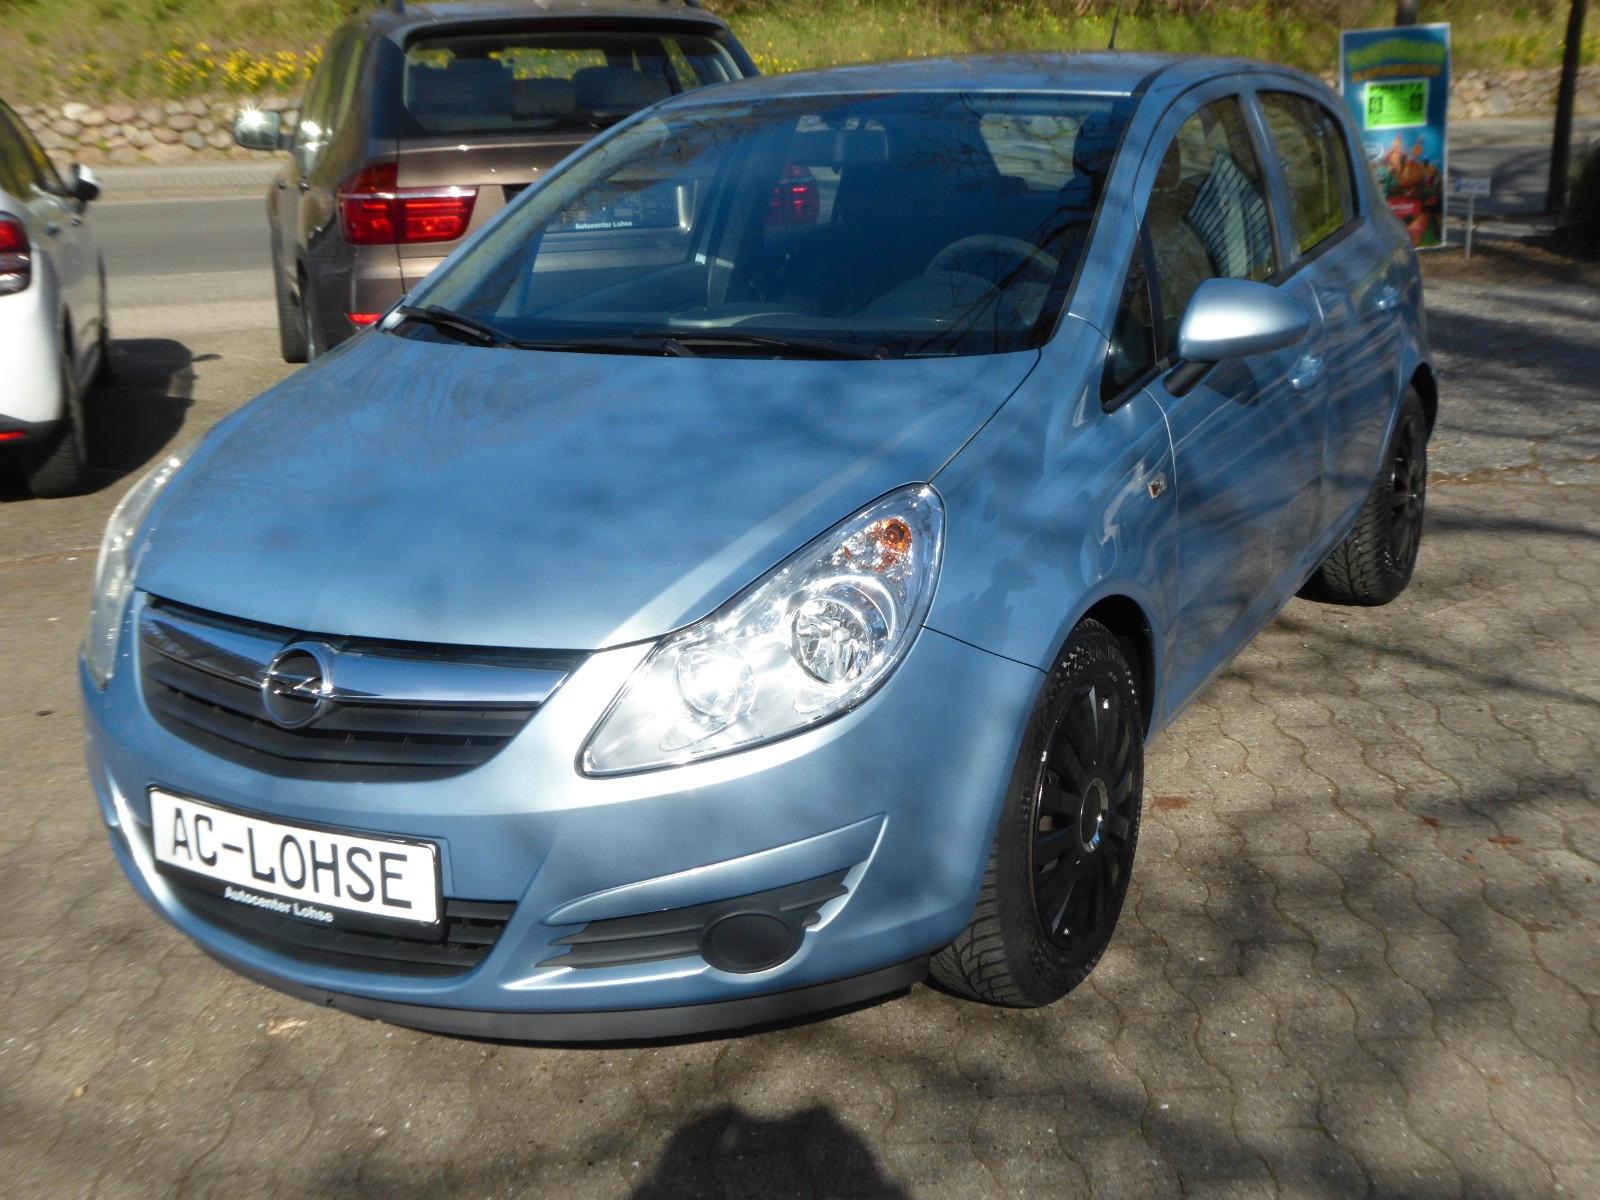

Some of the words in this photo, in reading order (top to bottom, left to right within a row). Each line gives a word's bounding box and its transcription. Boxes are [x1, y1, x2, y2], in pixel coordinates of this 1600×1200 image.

[174, 808, 412, 909] AC-LOHSE
[224, 886, 292, 913] Autocenter
[293, 902, 334, 923] Lohse
